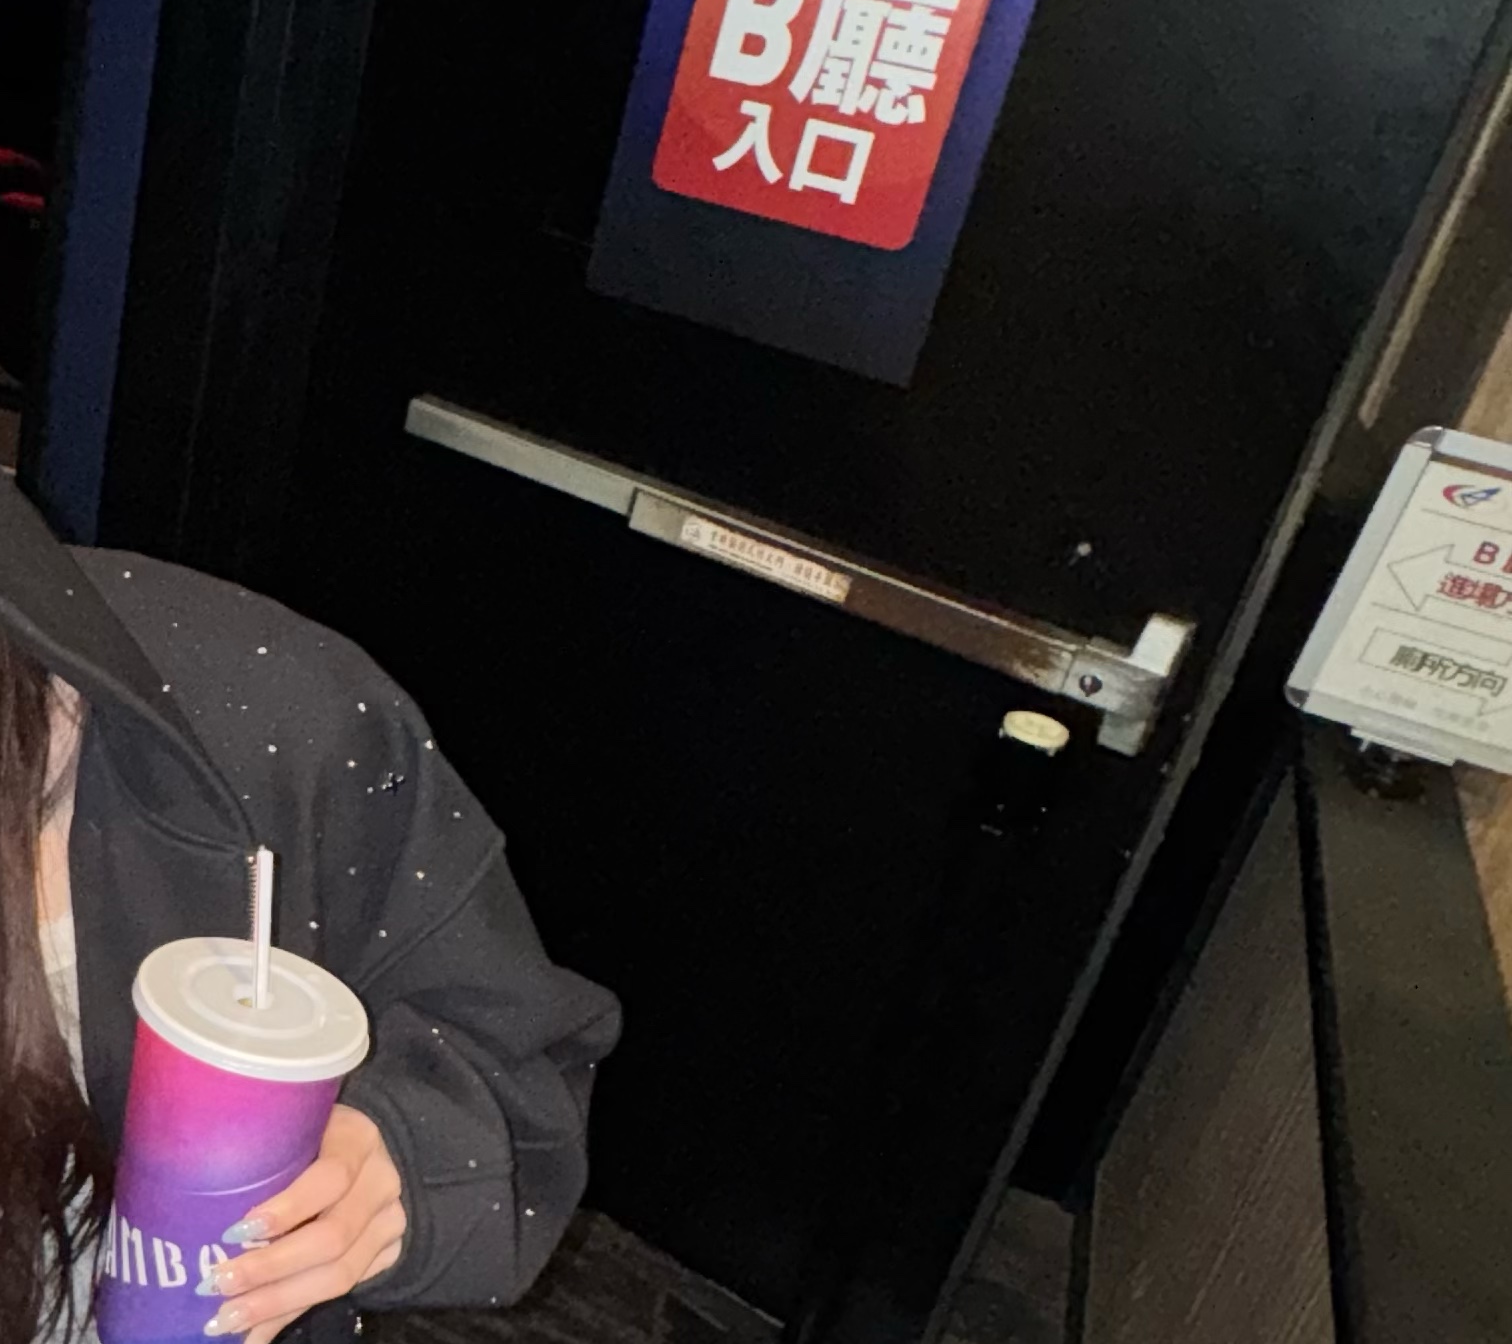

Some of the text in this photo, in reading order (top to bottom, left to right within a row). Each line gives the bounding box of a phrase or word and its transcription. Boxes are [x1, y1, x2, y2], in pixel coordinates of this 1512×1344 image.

[712, 99, 876, 206] 入口
[1389, 644, 1509, 698] 廁所方向
